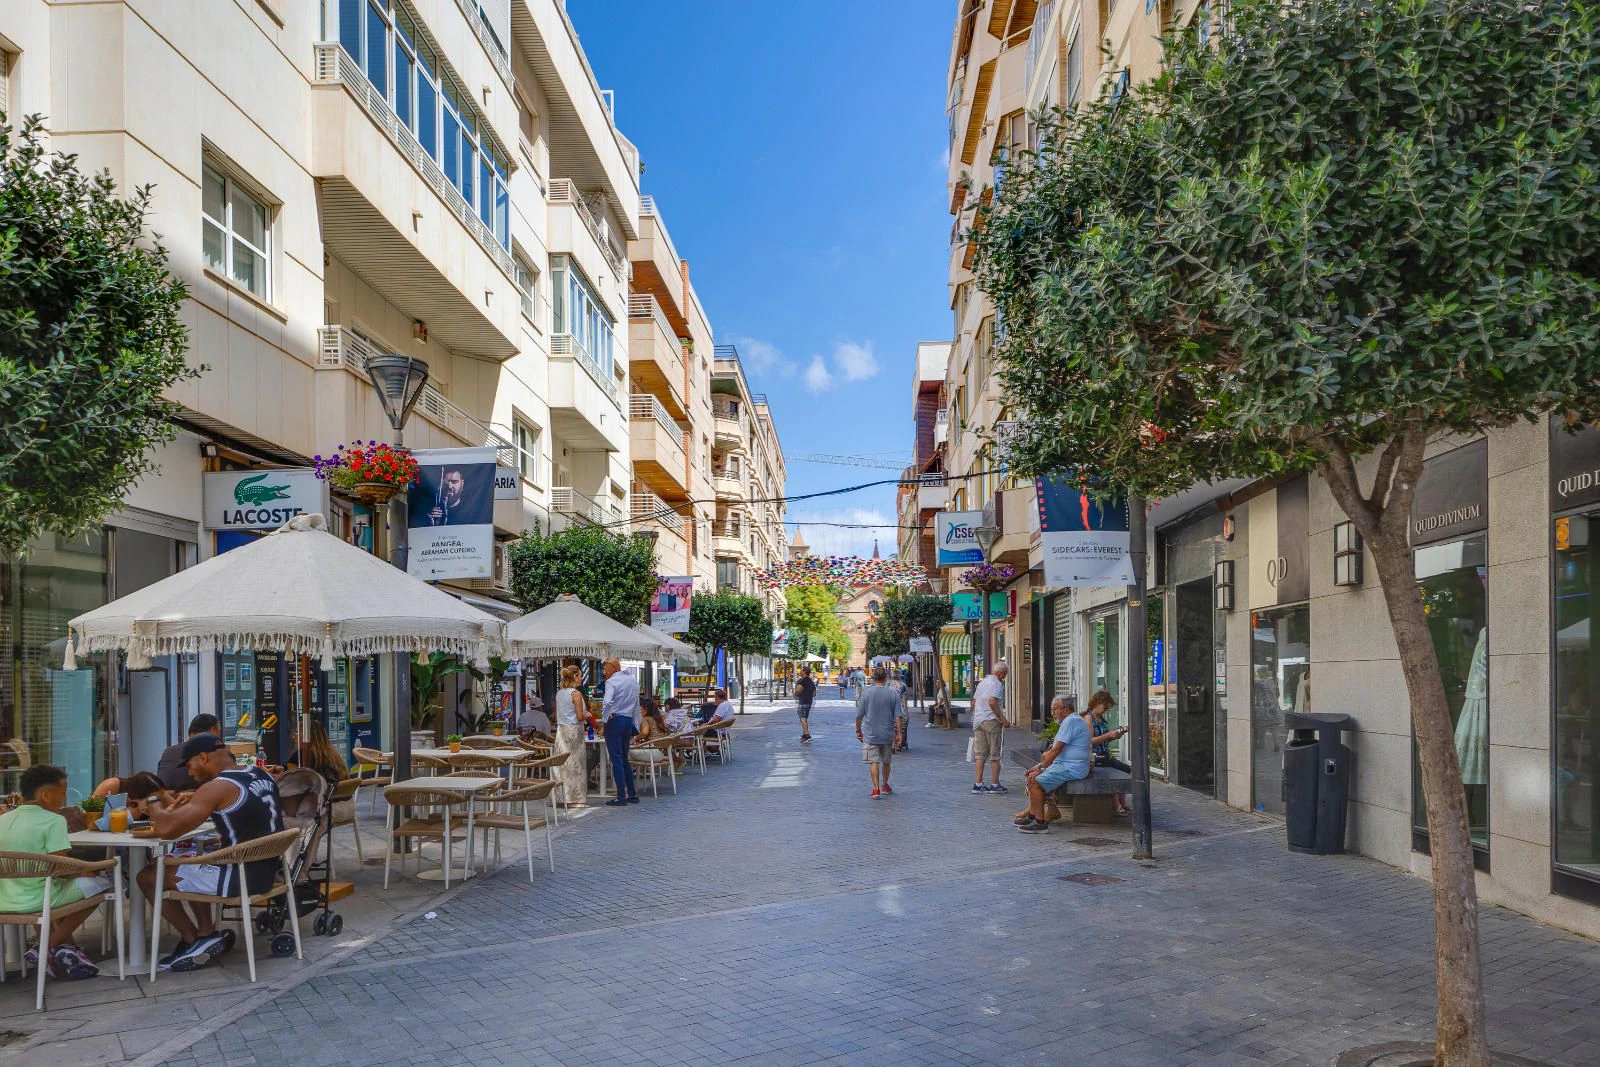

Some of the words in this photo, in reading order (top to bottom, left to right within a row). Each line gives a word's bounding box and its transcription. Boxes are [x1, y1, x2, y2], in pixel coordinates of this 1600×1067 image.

[1558, 473, 1592, 497] QUID
[1415, 516, 1437, 534] QUID
[1438, 504, 1480, 527] DIVINUM
[431, 540, 464, 548] PANGEA:
[1094, 546, 1122, 554] EVEREST
[1267, 556, 1288, 588] QD
